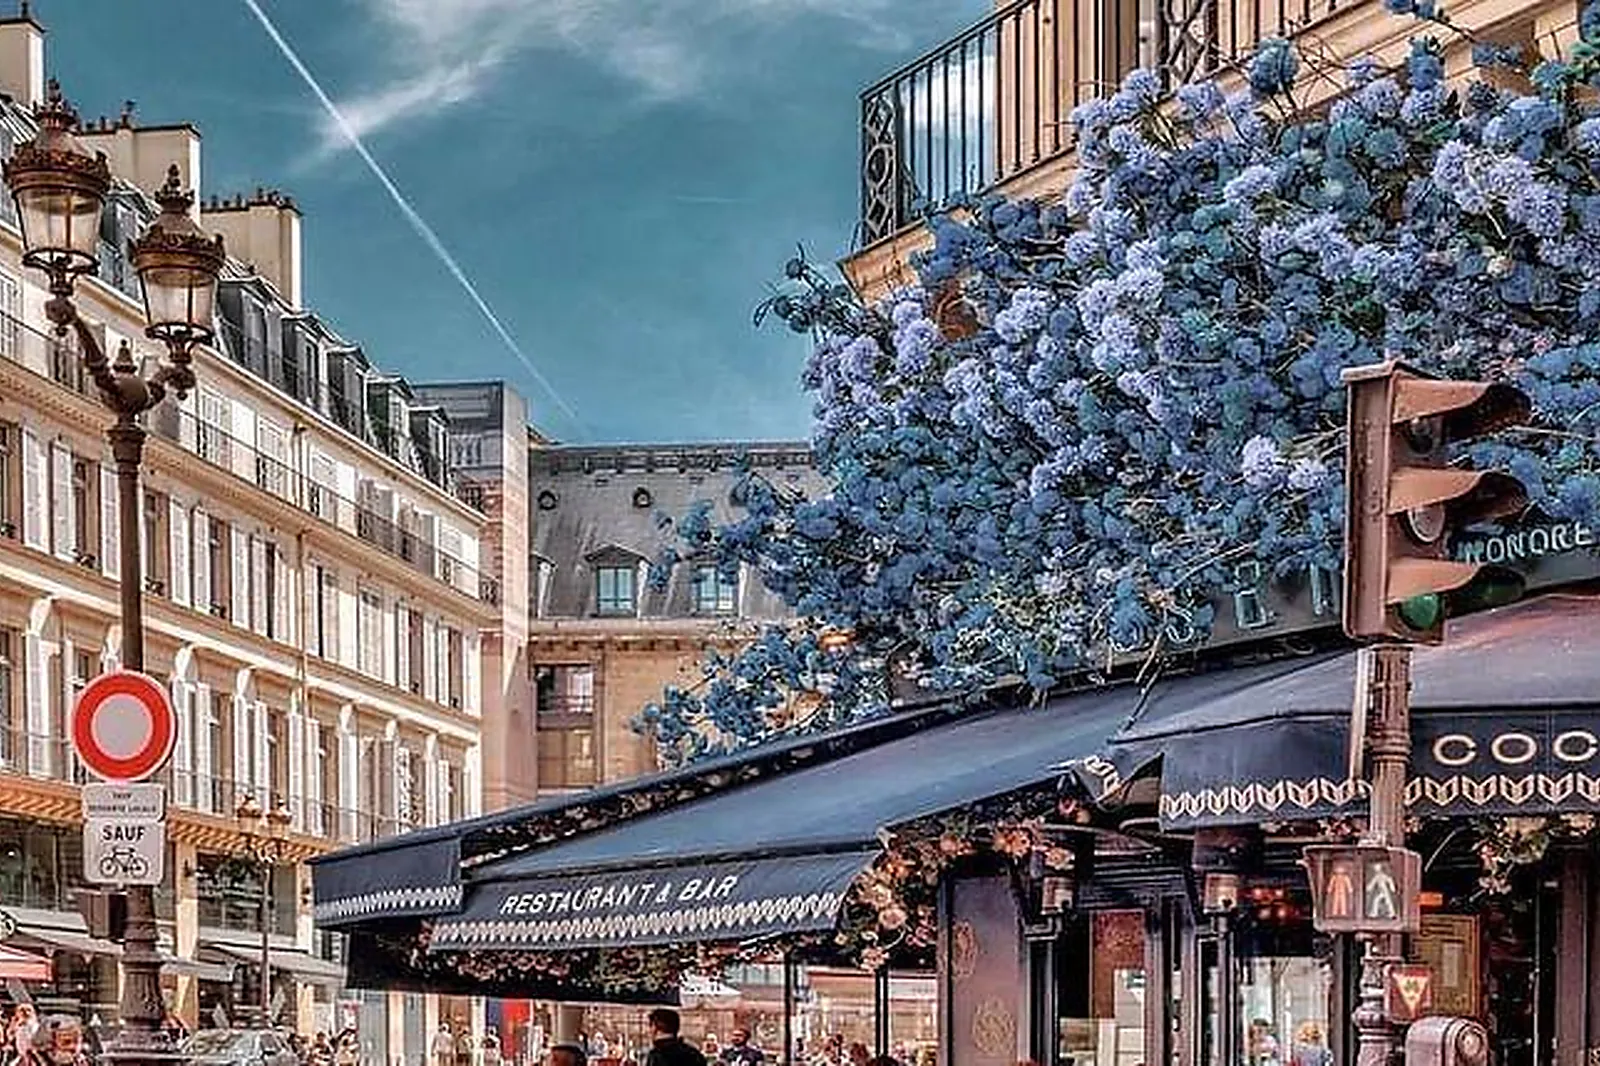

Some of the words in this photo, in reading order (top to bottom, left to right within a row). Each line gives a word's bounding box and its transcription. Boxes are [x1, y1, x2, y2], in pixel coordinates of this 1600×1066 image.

[1433, 730, 1598, 766] COC
[102, 825, 146, 841] SAUF
[500, 883, 655, 914] RESTAURANT
[679, 875, 738, 901] BAR
